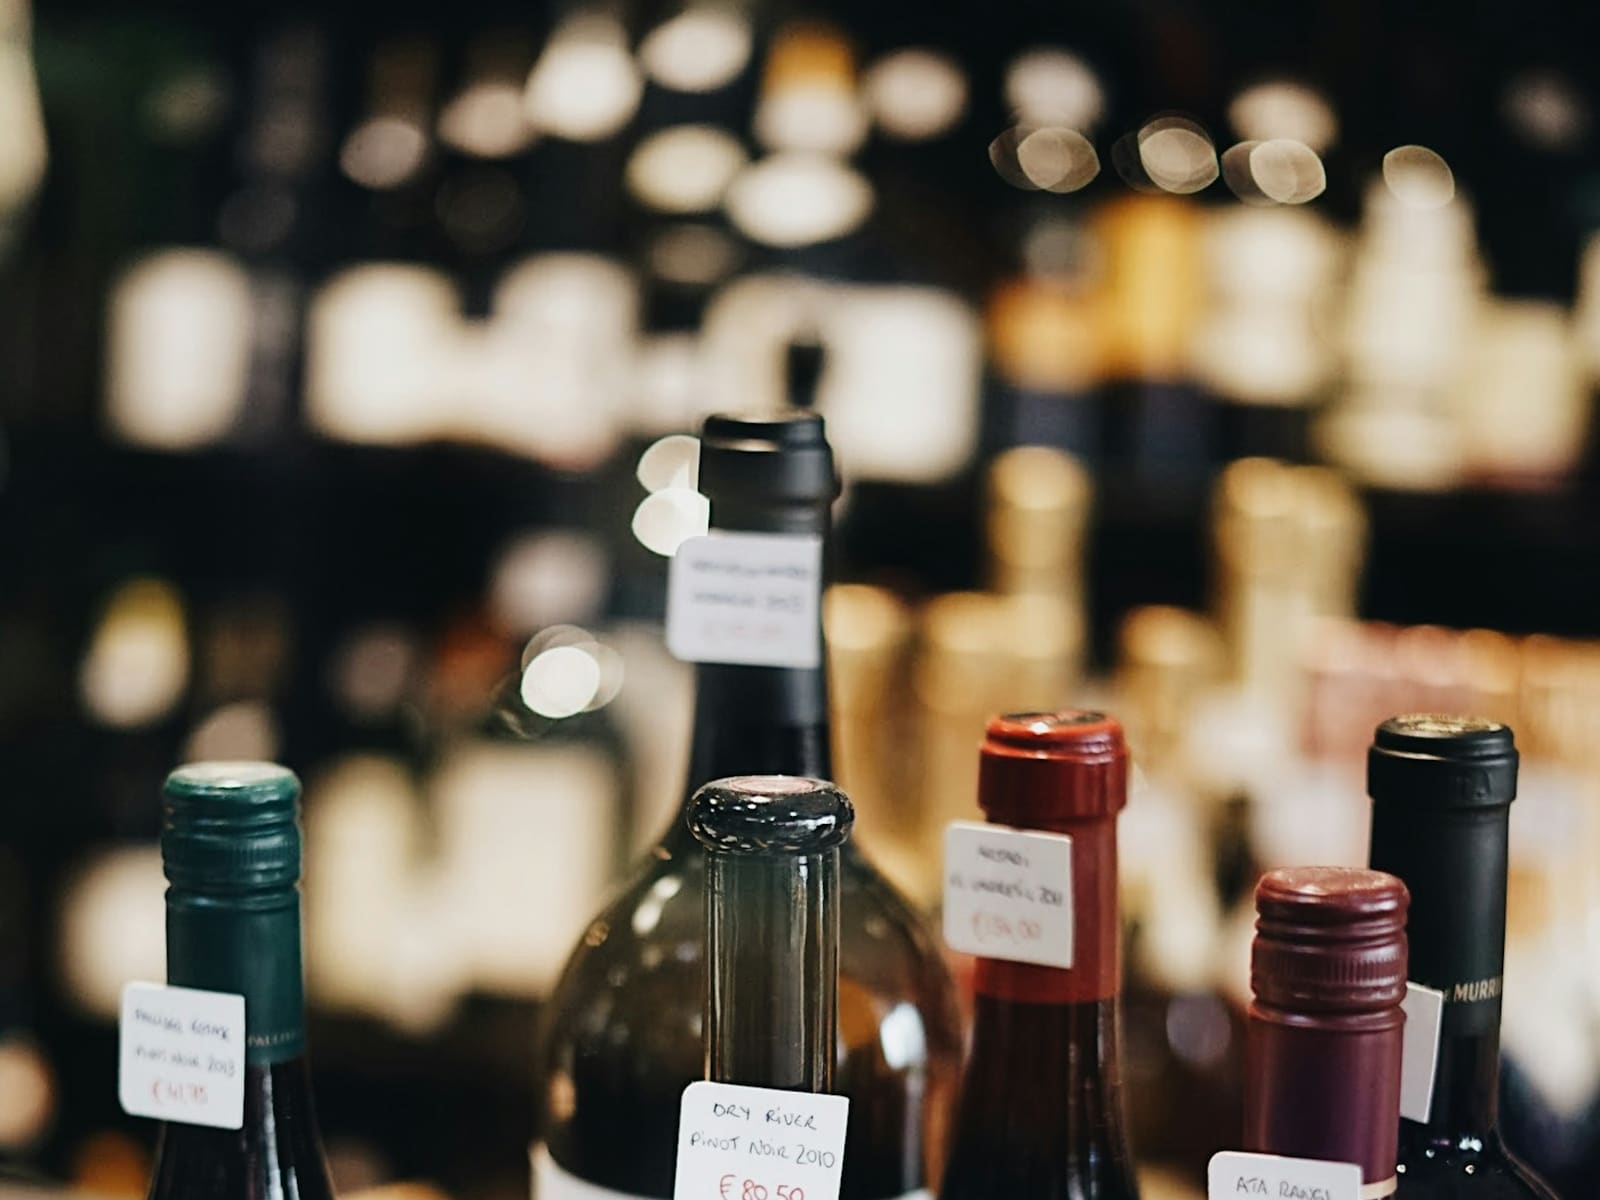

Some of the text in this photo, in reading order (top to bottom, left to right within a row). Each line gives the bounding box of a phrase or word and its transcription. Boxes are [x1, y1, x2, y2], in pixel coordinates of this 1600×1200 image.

[713, 1103, 750, 1120] DRY
[792, 1144, 836, 1168] 2010
[1236, 1176, 1268, 1195] ATA
